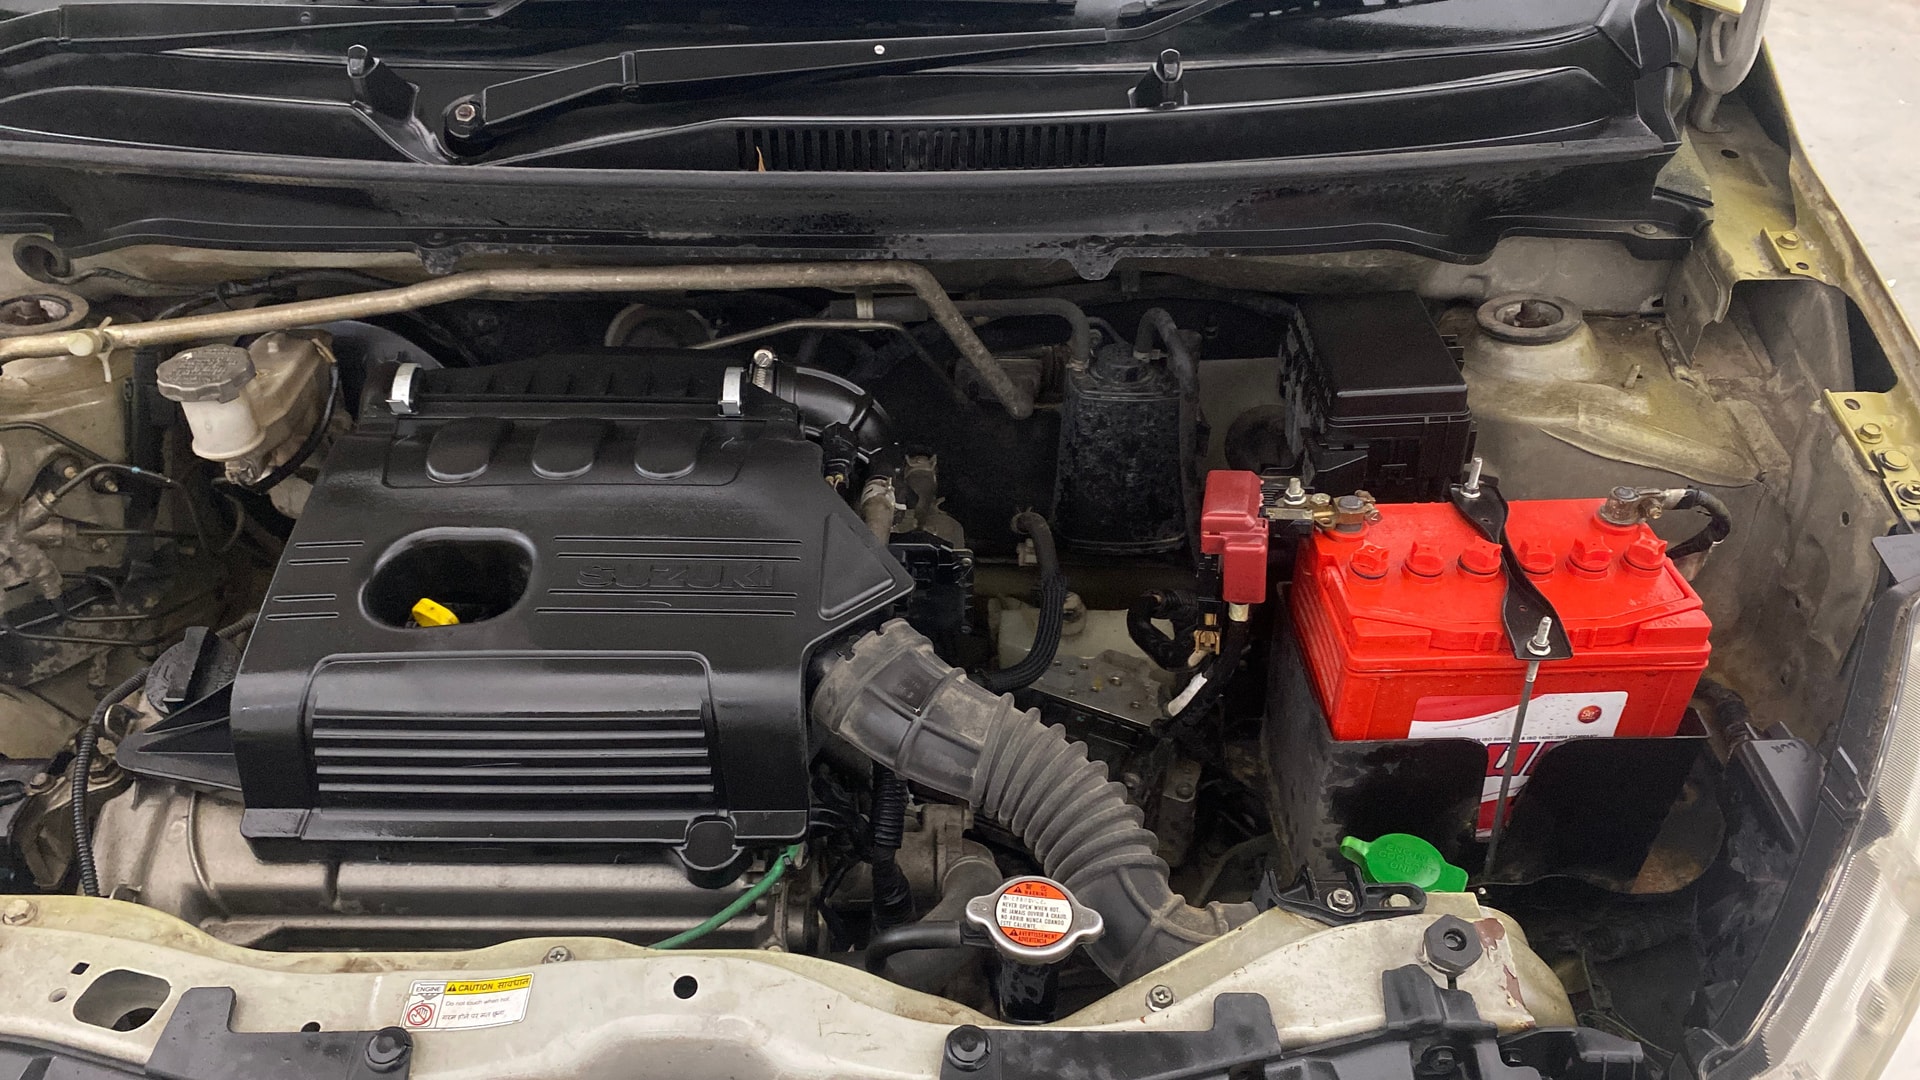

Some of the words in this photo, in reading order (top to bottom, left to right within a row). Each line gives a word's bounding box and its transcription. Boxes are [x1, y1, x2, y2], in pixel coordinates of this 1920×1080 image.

[576, 562, 777, 590] SUZUKI
[1002, 901, 1017, 909] NEVER
[1000, 919, 1012, 927] ESTE
[1045, 918, 1065, 926] CUANDO
[458, 983, 494, 992] CAUTION
[497, 978, 530, 989] सावधान
